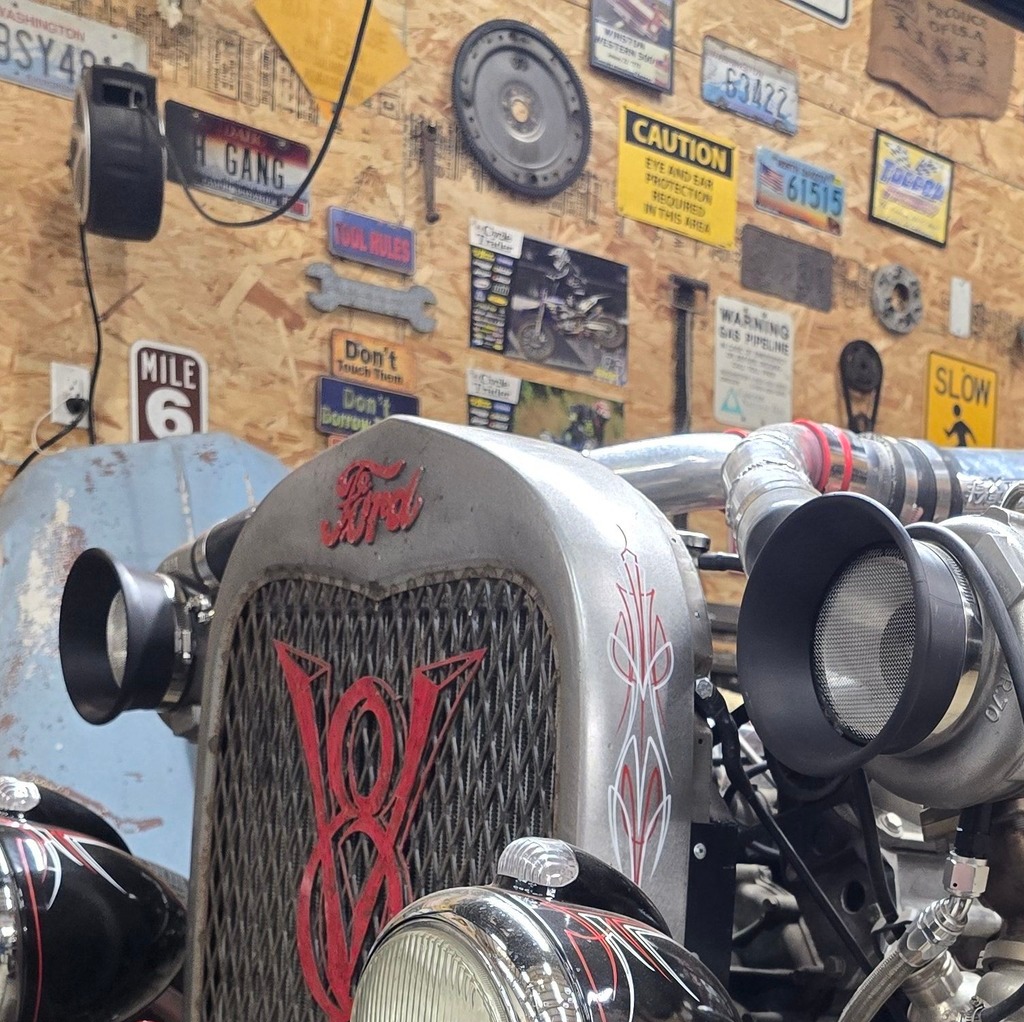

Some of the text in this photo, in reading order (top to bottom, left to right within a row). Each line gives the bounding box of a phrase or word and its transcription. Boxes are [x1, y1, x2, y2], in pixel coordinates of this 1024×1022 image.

[631, 119, 727, 173] CAUTION
[225, 142, 286, 190] GANG
[645, 157, 714, 192] EYE AND EAR
[645, 172, 713, 207] PROTECTION
[652, 190, 707, 218] REQUIRED
[787, 174, 844, 217] 61515
[643, 201, 711, 236] IN THIS AREA
[720, 307, 790, 341] WARNING
[345, 339, 397, 372] Don't
[744, 332, 790, 357] PIPELINE
[140, 350, 198, 391] MILE
[933, 361, 991, 408] SLOW
[144, 386, 195, 439] 6
[342, 386, 391, 418] Don't
[319, 458, 424, 549] Ford
